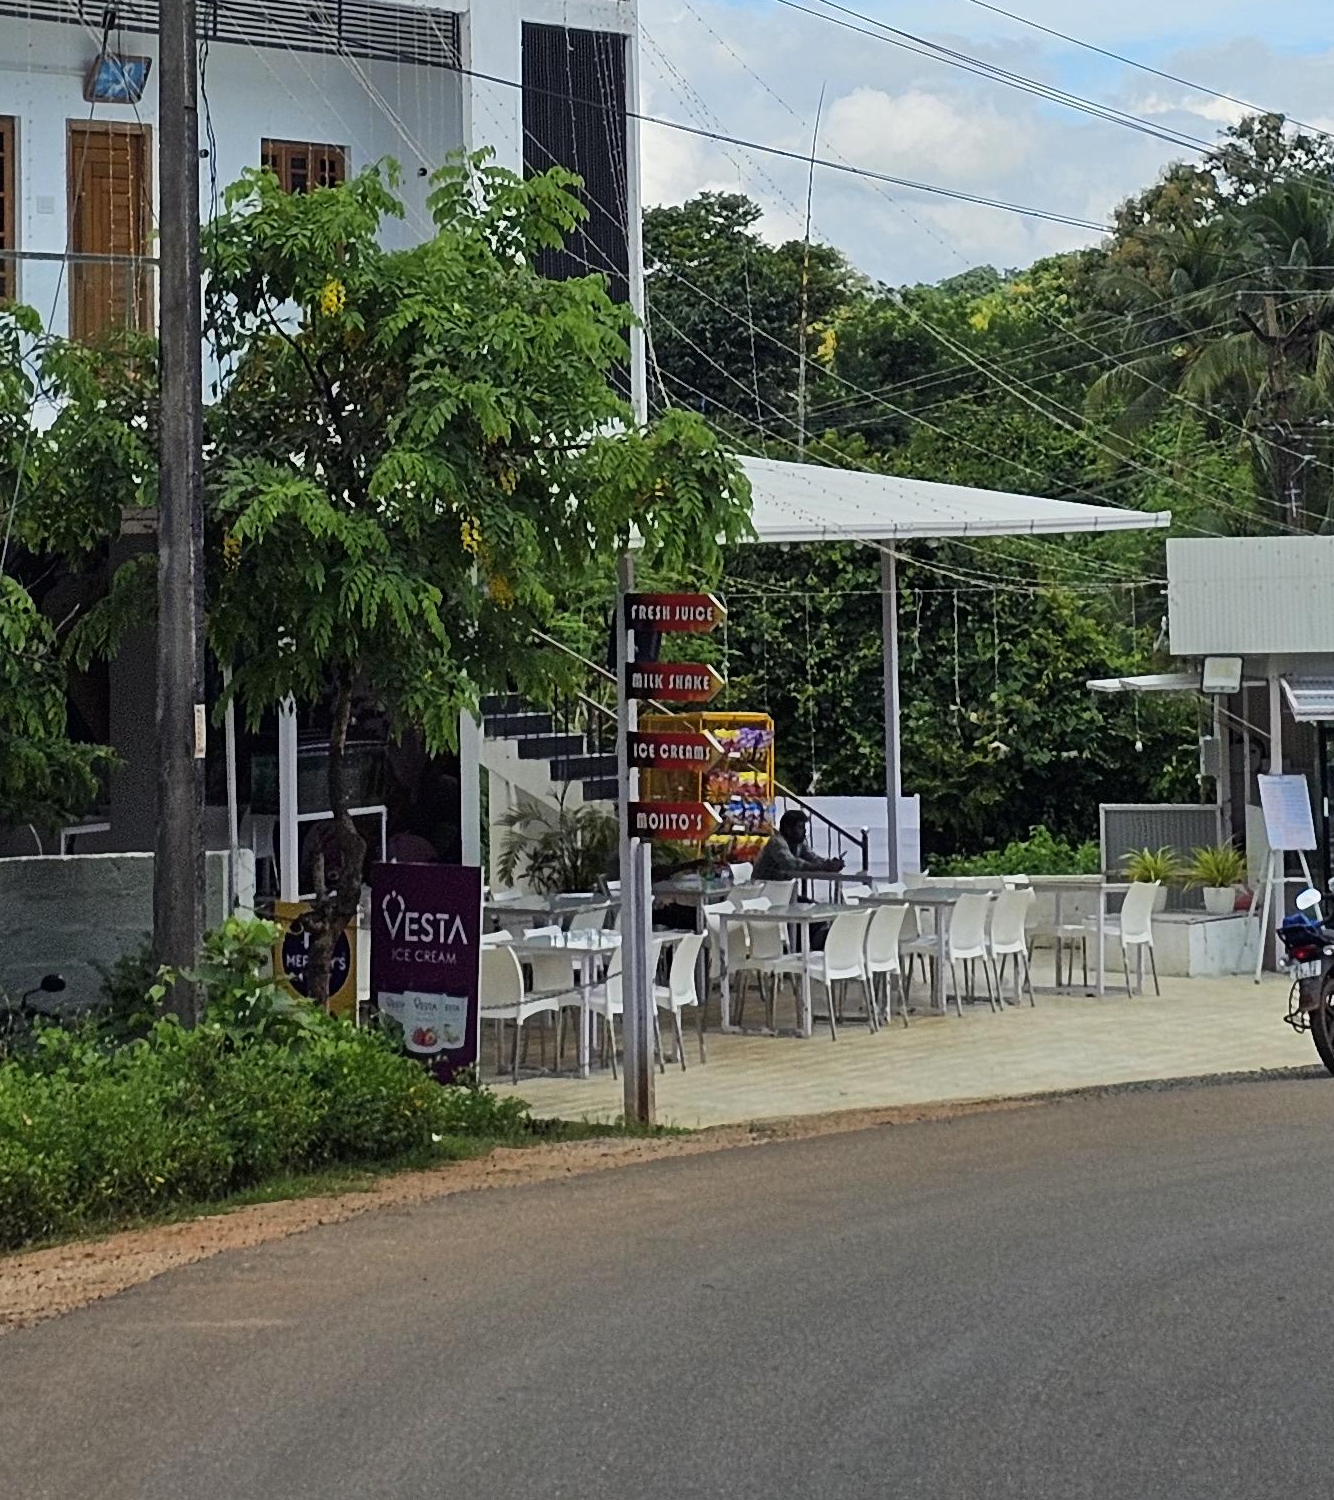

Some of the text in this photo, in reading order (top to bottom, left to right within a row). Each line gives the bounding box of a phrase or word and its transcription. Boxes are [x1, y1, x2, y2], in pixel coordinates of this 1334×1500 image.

[631, 605, 713, 621] FRESH JUICE
[632, 673, 710, 690] MILK SHAKE
[633, 743, 710, 760] ICE CREAMS
[636, 812, 702, 831] MOJITO'S
[382, 890, 468, 945] VESTA
[391, 947, 457, 964] ICE CREAM
